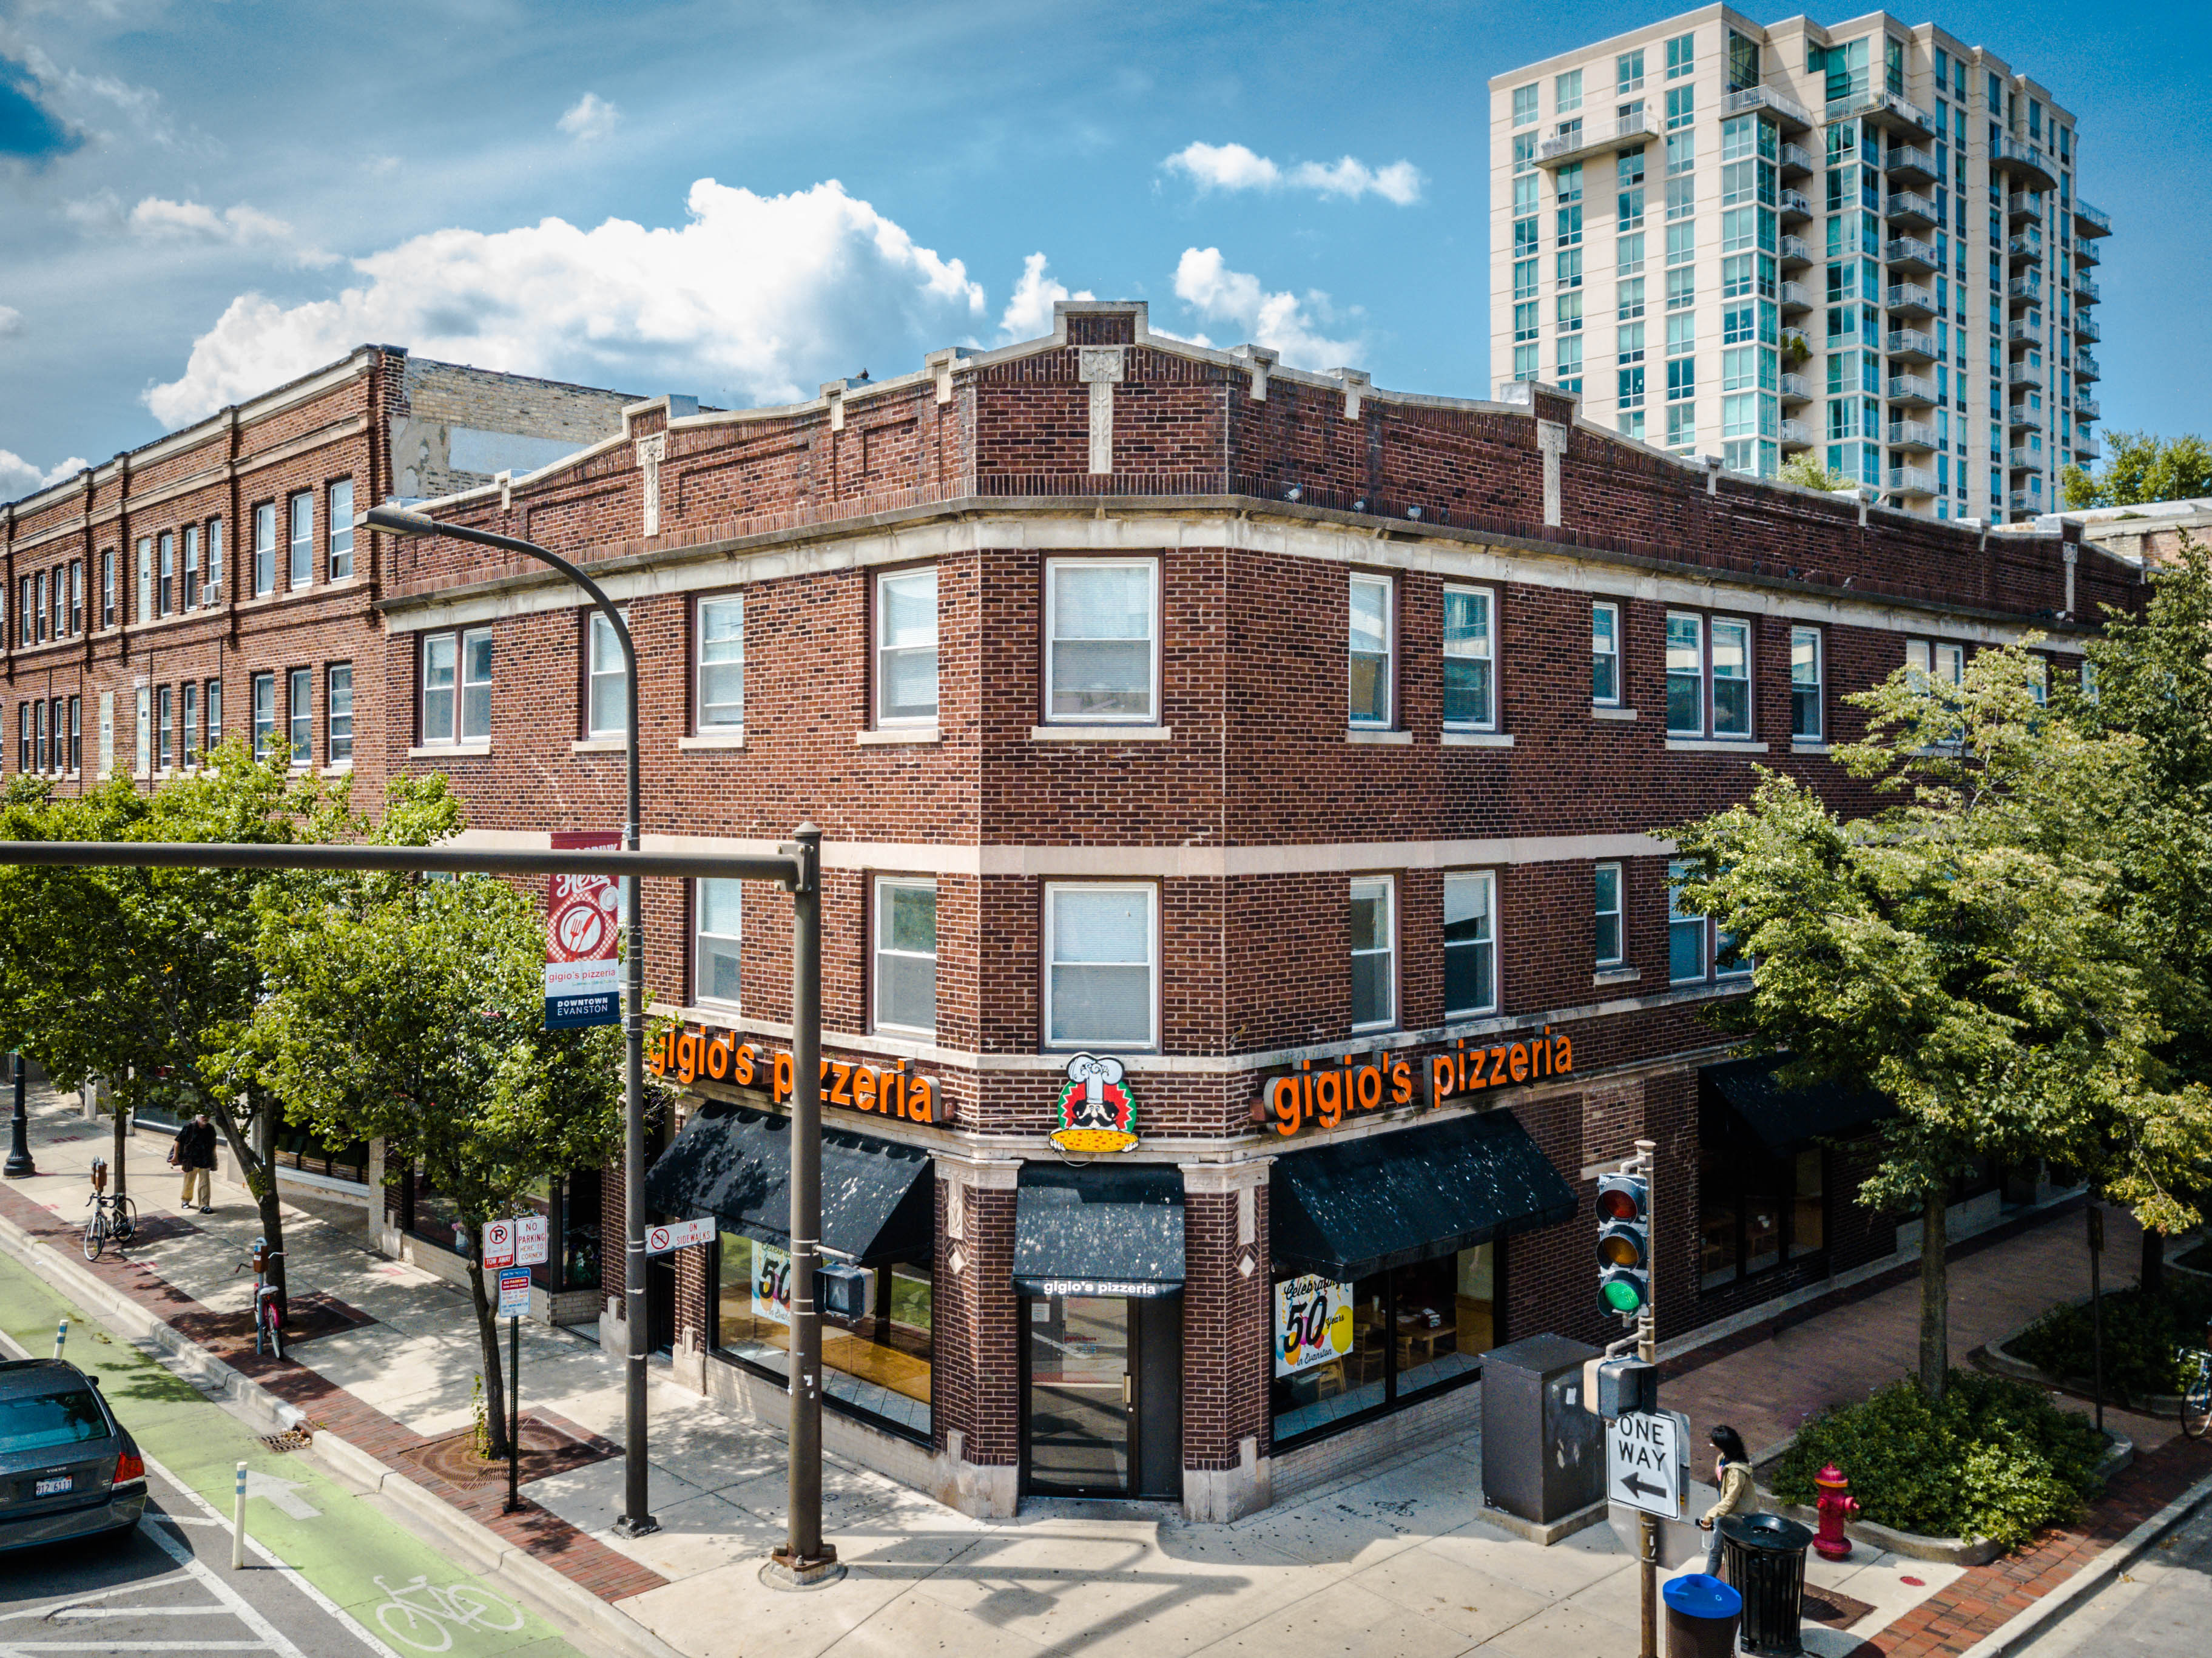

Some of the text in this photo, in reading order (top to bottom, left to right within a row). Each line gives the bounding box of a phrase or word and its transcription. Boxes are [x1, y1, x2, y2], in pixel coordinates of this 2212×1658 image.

[549, 971, 579, 983] gigio's
[582, 969, 615, 980] pizzeria
[558, 997, 608, 1007] DOWNTOWN
[558, 1005, 608, 1016] EVANSTON
[649, 1023, 932, 1123] gigio's pzeria
[1273, 1025, 1573, 1136] gigio's pizzeria
[526, 1222, 538, 1232] NO
[689, 1222, 697, 1232] ON
[519, 1233, 545, 1244] PARKING
[676, 1230, 710, 1245] SIDEWALKS
[521, 1252, 542, 1260] CORNER
[1044, 1281, 1156, 1295] gigio's pizzeria
[1284, 1295, 1344, 1353] 50 Years
[1304, 1348, 1332, 1364] Evanston
[1620, 1416, 1664, 1446] ONE
[1619, 1440, 1667, 1471] WAY
